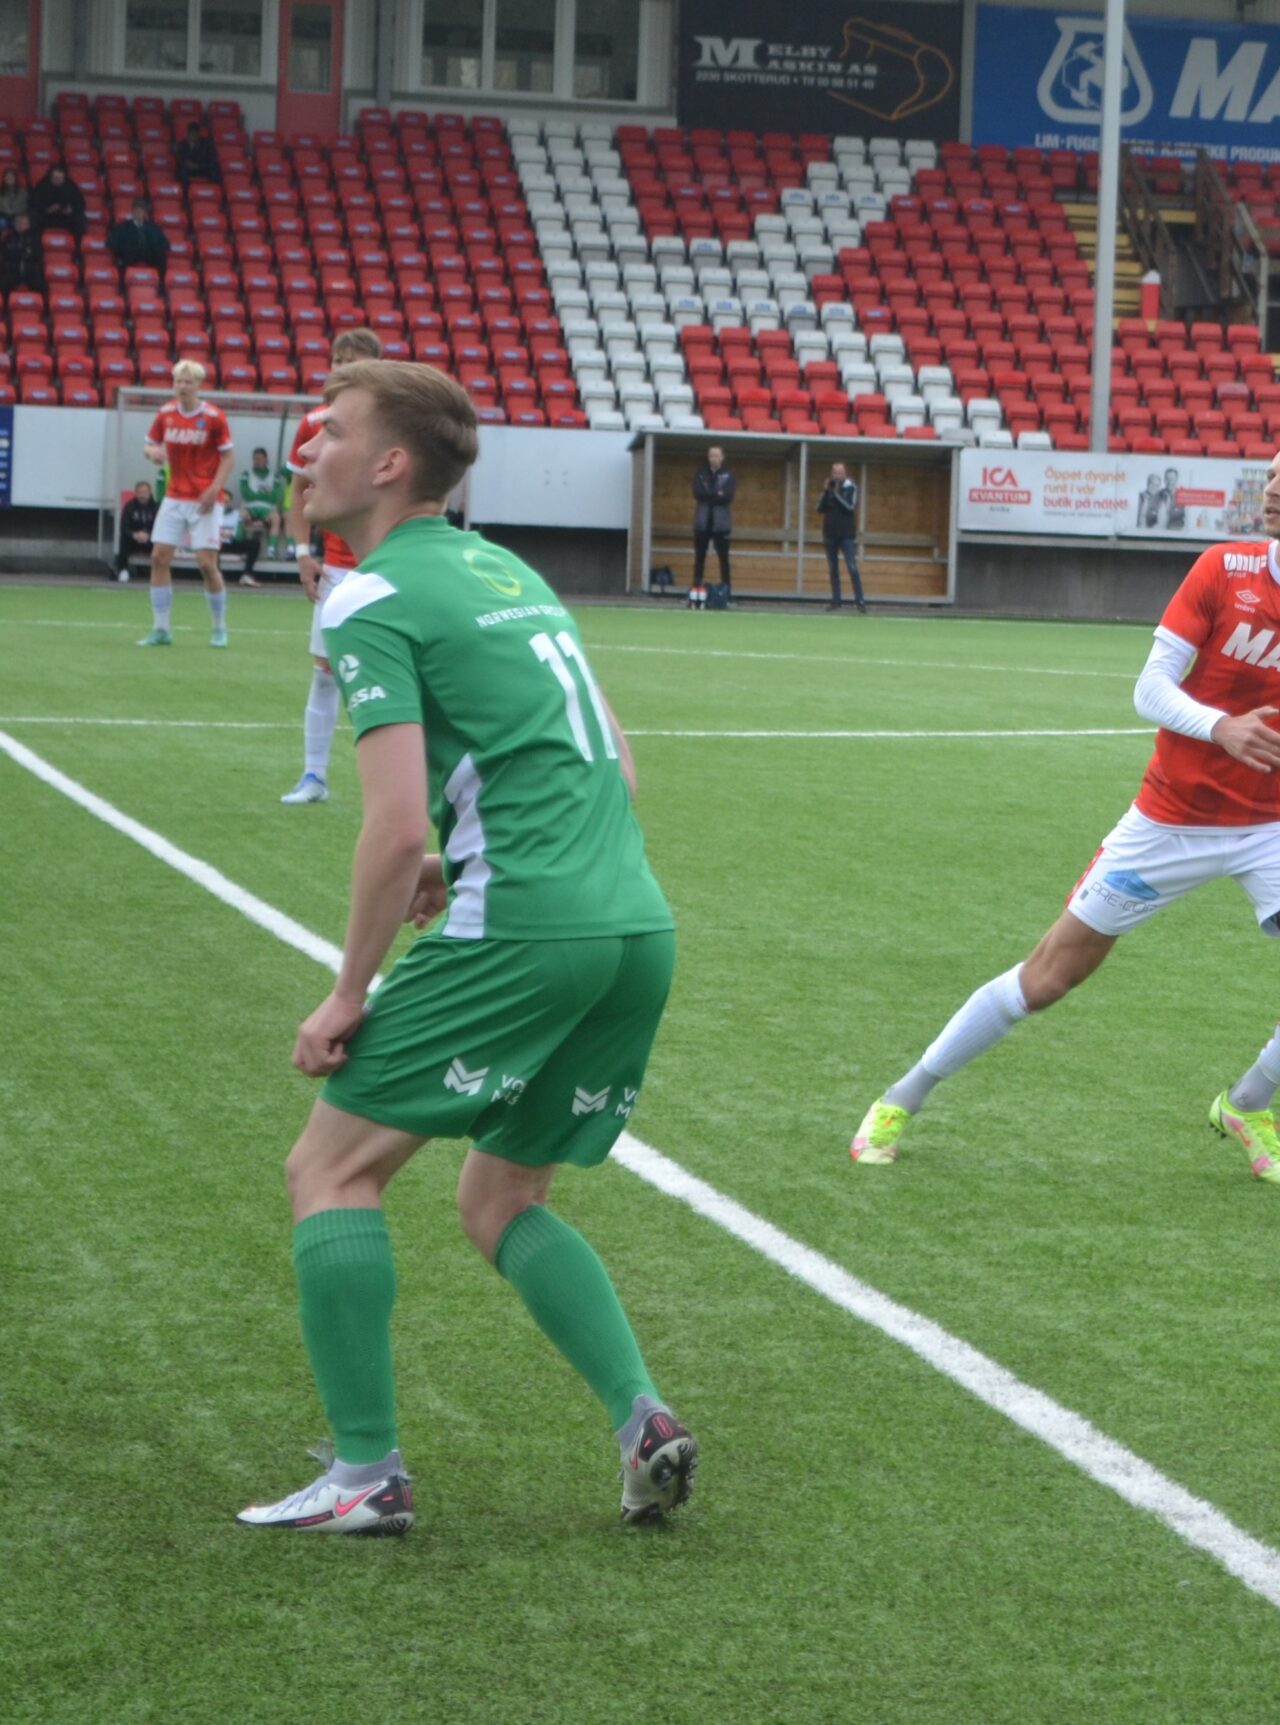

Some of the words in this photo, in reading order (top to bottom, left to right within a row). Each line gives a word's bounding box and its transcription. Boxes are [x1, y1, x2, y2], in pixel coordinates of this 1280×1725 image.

[982, 467, 1018, 488] ICA
[972, 491, 1028, 504] KVANTUM
[474, 605, 541, 628] NORWEGIAN
[528, 630, 618, 763] 11
